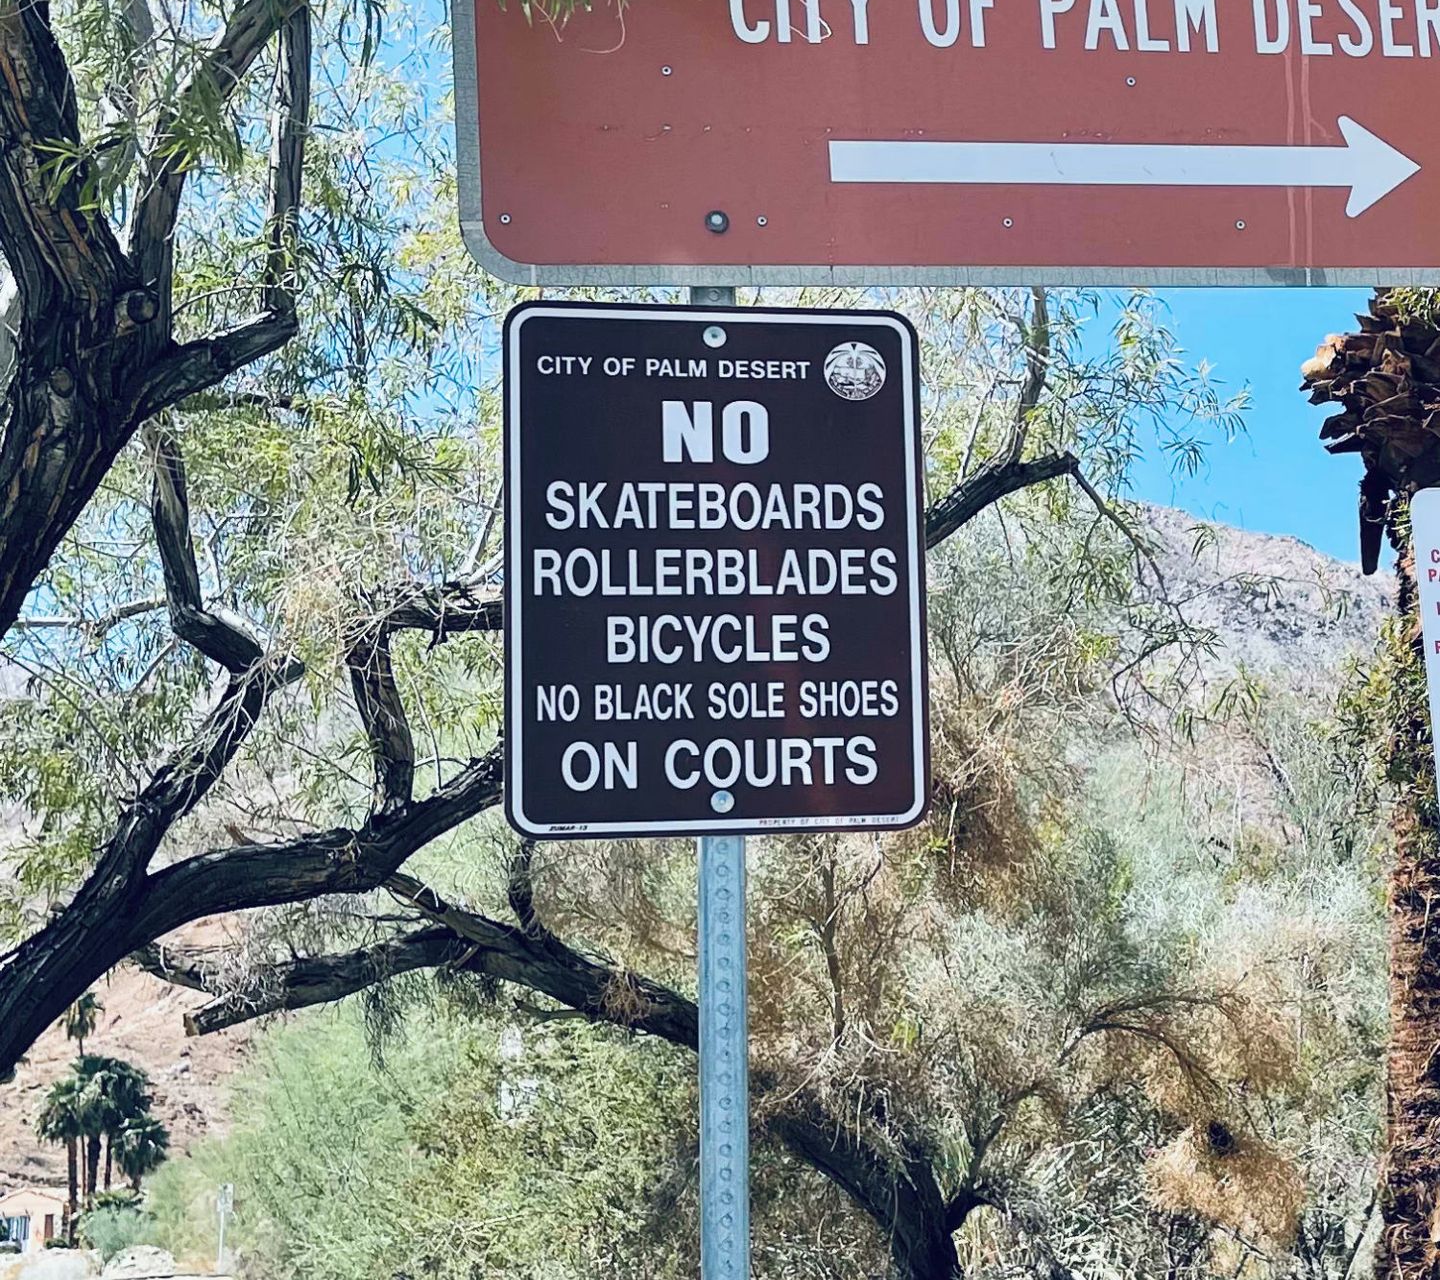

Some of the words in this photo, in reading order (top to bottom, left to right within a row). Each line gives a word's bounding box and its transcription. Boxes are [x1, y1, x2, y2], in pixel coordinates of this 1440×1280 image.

[537, 355, 593, 375] CITY
[603, 357, 636, 376] OF
[645, 358, 708, 378] PALM
[718, 360, 811, 379] DESERT
[661, 400, 770, 465] NO
[545, 480, 885, 531] SKATEBOARDS
[533, 547, 898, 597] ROLLERBLADES
[606, 613, 830, 664] BICYCLES
[536, 684, 580, 722] NO
[594, 682, 695, 721] BLACK
[707, 681, 785, 719] SOLE
[799, 679, 899, 718] SHOES
[561, 741, 638, 792] ON
[664, 736, 879, 790] COURTS
